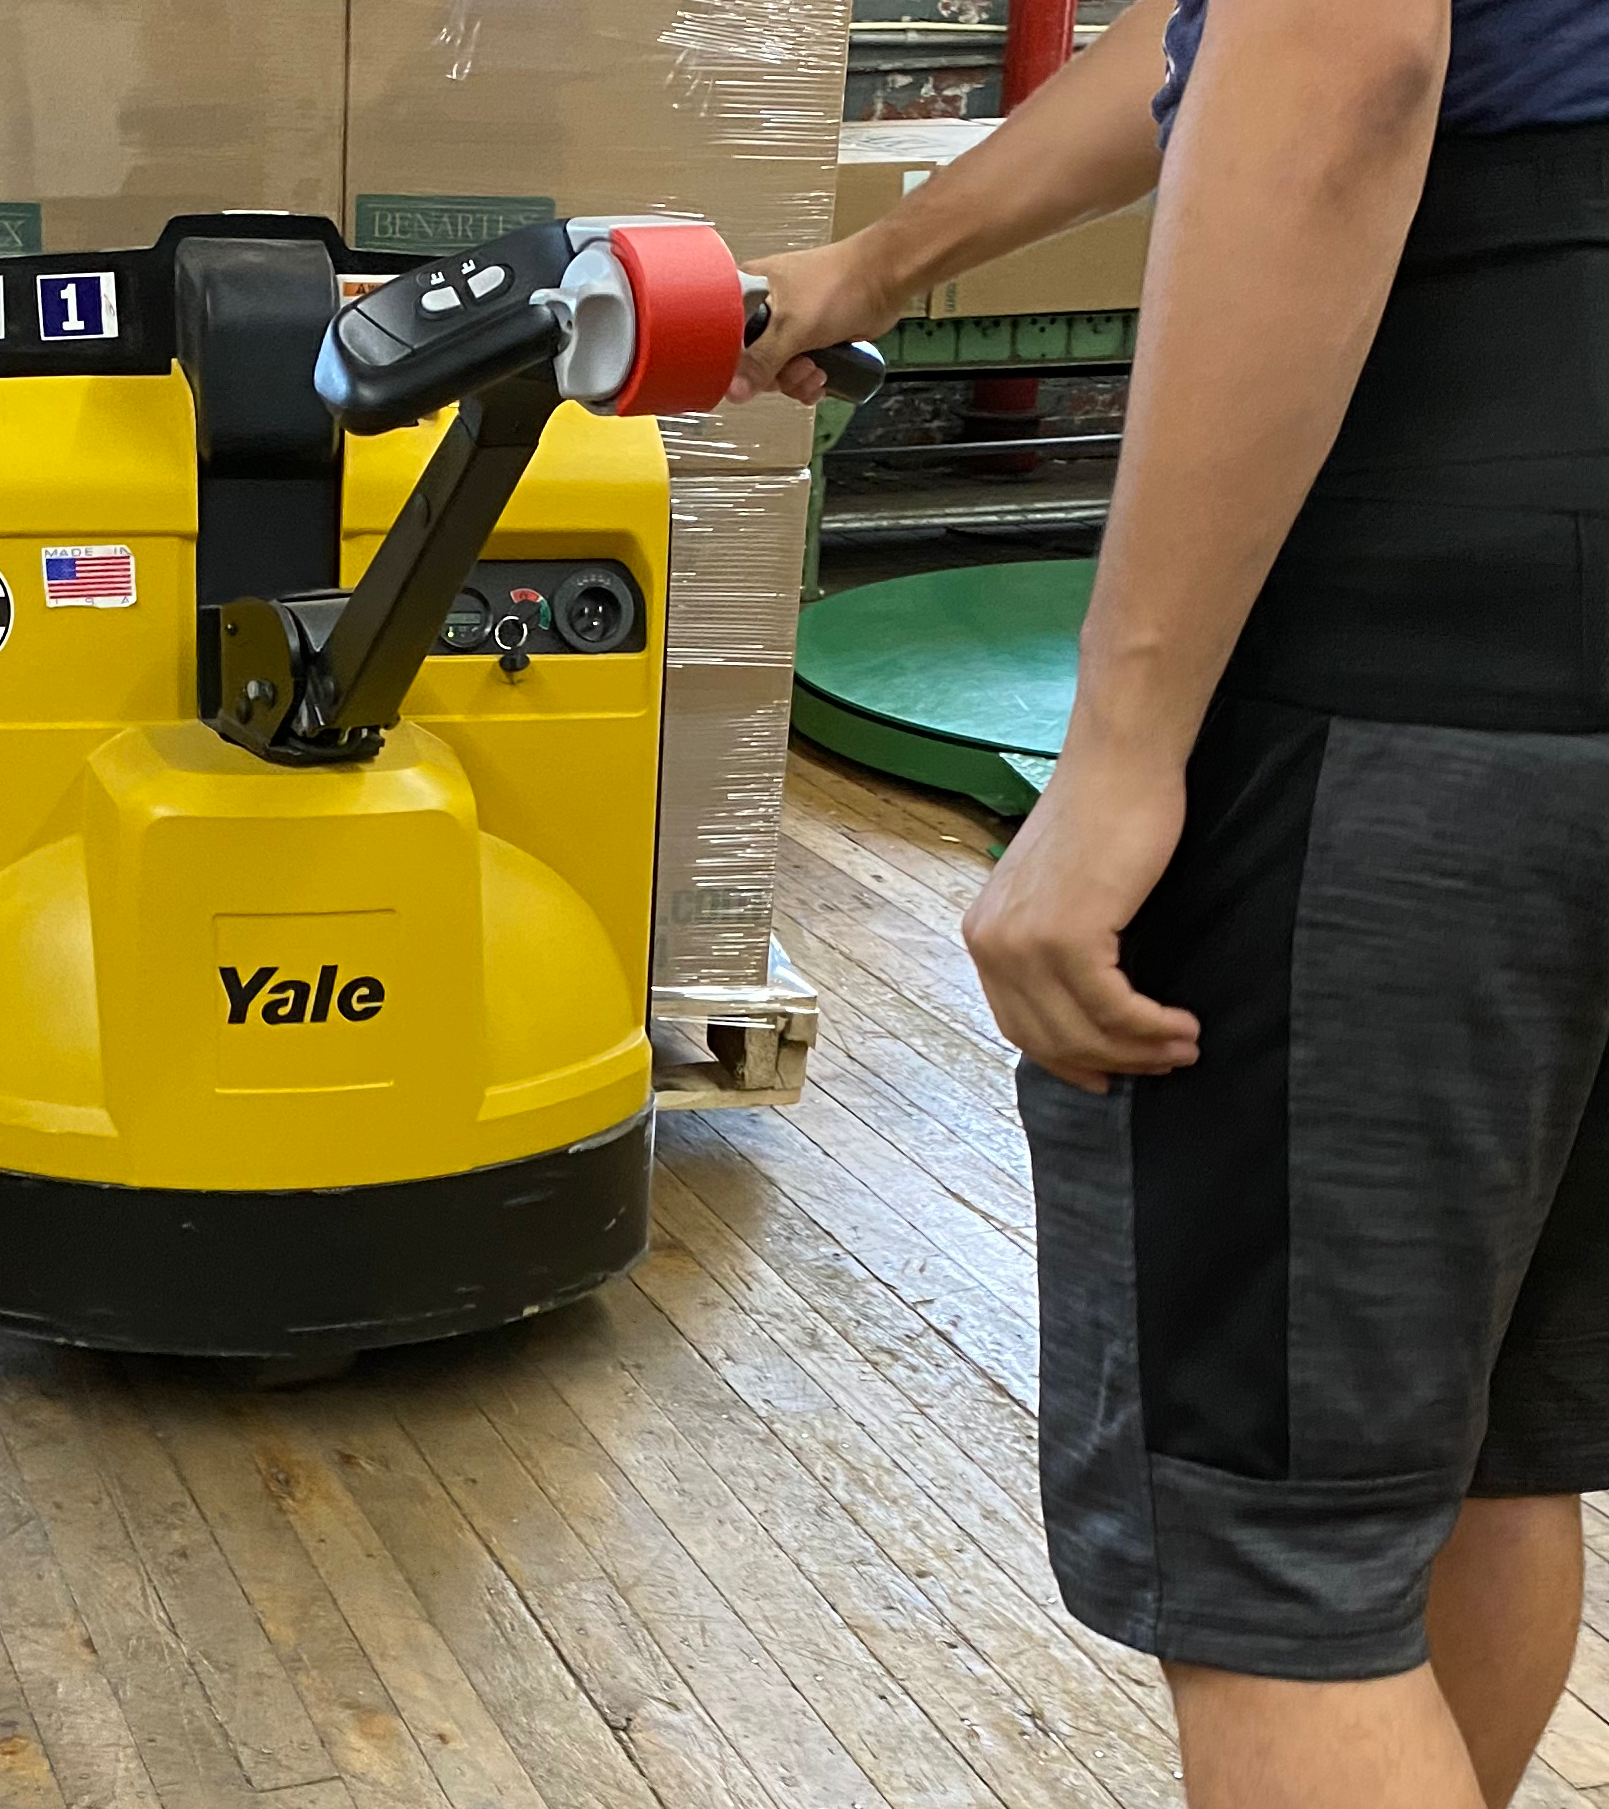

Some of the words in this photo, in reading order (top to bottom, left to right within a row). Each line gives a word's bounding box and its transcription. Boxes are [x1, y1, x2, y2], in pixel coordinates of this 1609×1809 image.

[59, 283, 85, 331] 1
[44, 547, 94, 558] MADE
[113, 546, 132, 556] IN
[218, 965, 386, 1026] Yale
